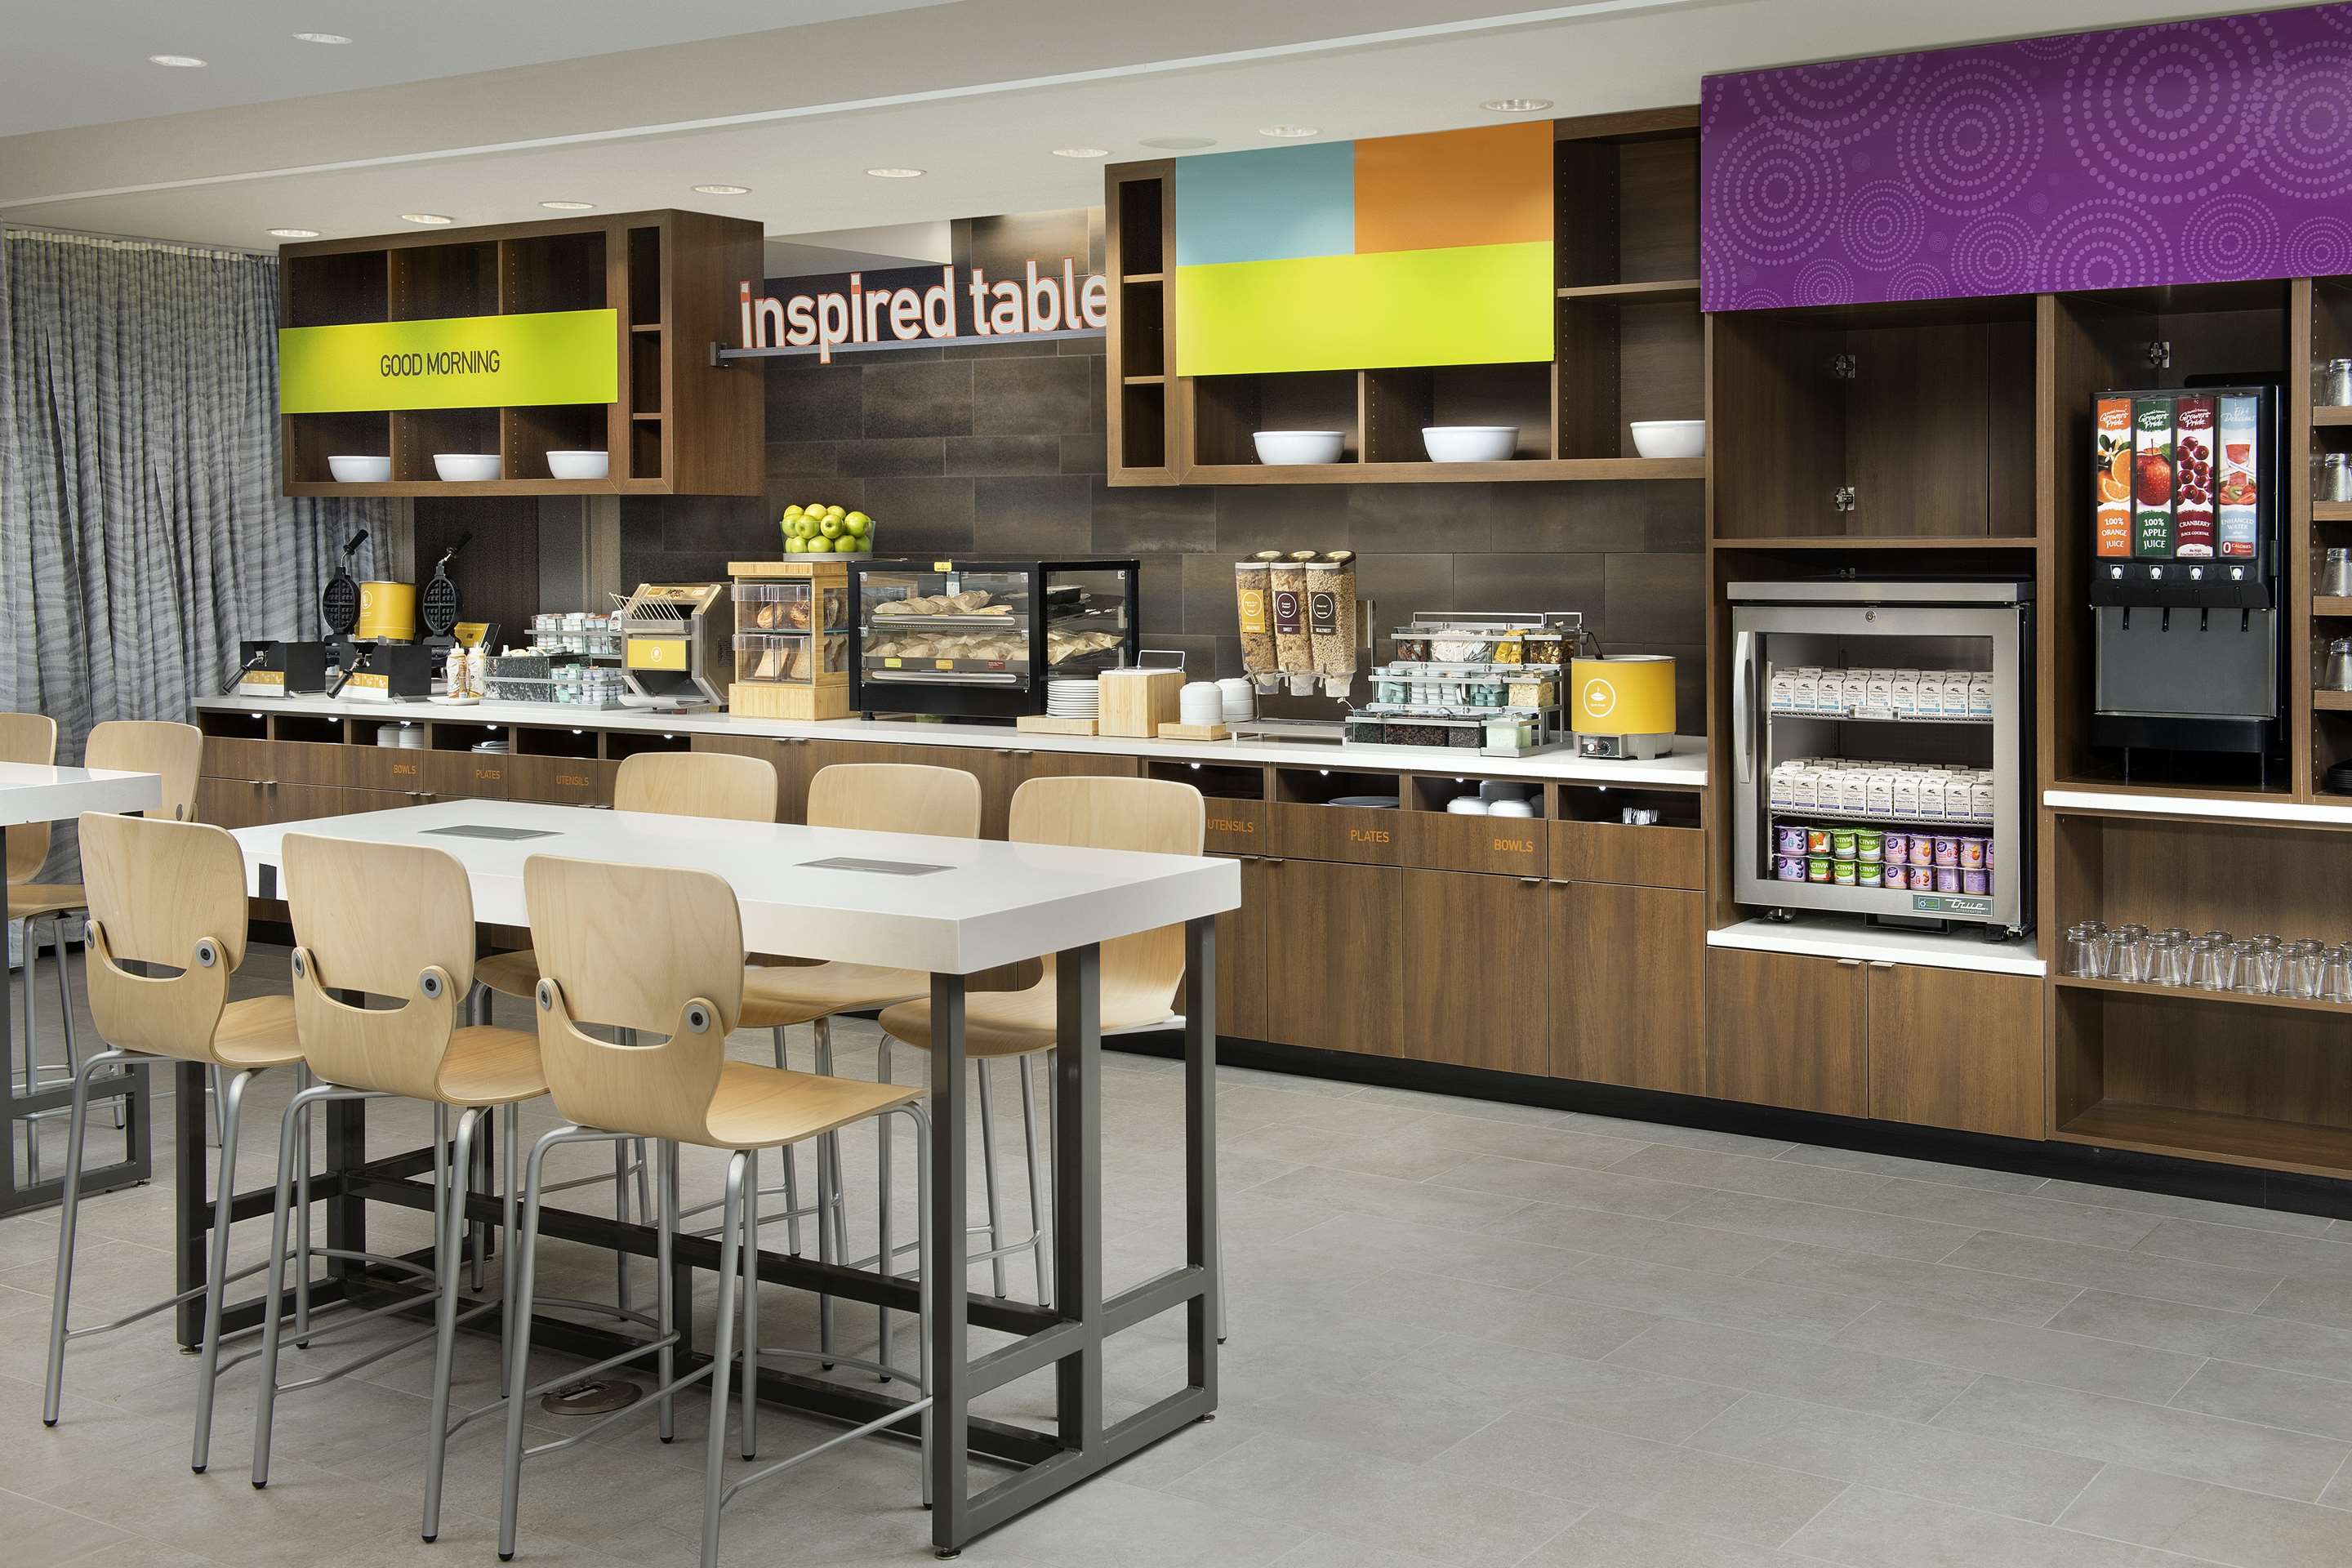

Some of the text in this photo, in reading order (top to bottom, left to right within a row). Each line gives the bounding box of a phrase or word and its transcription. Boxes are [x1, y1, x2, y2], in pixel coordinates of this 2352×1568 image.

[740, 256, 1107, 364] inspired table
[381, 350, 500, 377] GOOD MORNING
[2105, 419, 2123, 428] Pride
[2144, 419, 2163, 429] Pride
[2185, 418, 2206, 427] Pride
[2105, 517, 2124, 526] 100%
[2144, 518, 2164, 527] 100%
[2101, 528, 2128, 537] ORANGE
[2143, 528, 2167, 537] APPLE
[2106, 540, 2124, 549] JUICE
[2144, 540, 2166, 550] JUICE
[2223, 541, 2231, 554] 0
[393, 764, 416, 774] BOWLS
[476, 769, 501, 779] PLATES
[556, 776, 589, 786] UTENSILS
[1207, 818, 1254, 833] UTENSILS
[1351, 829, 1389, 843] PLATES
[1494, 839, 1534, 853] BOWLS
